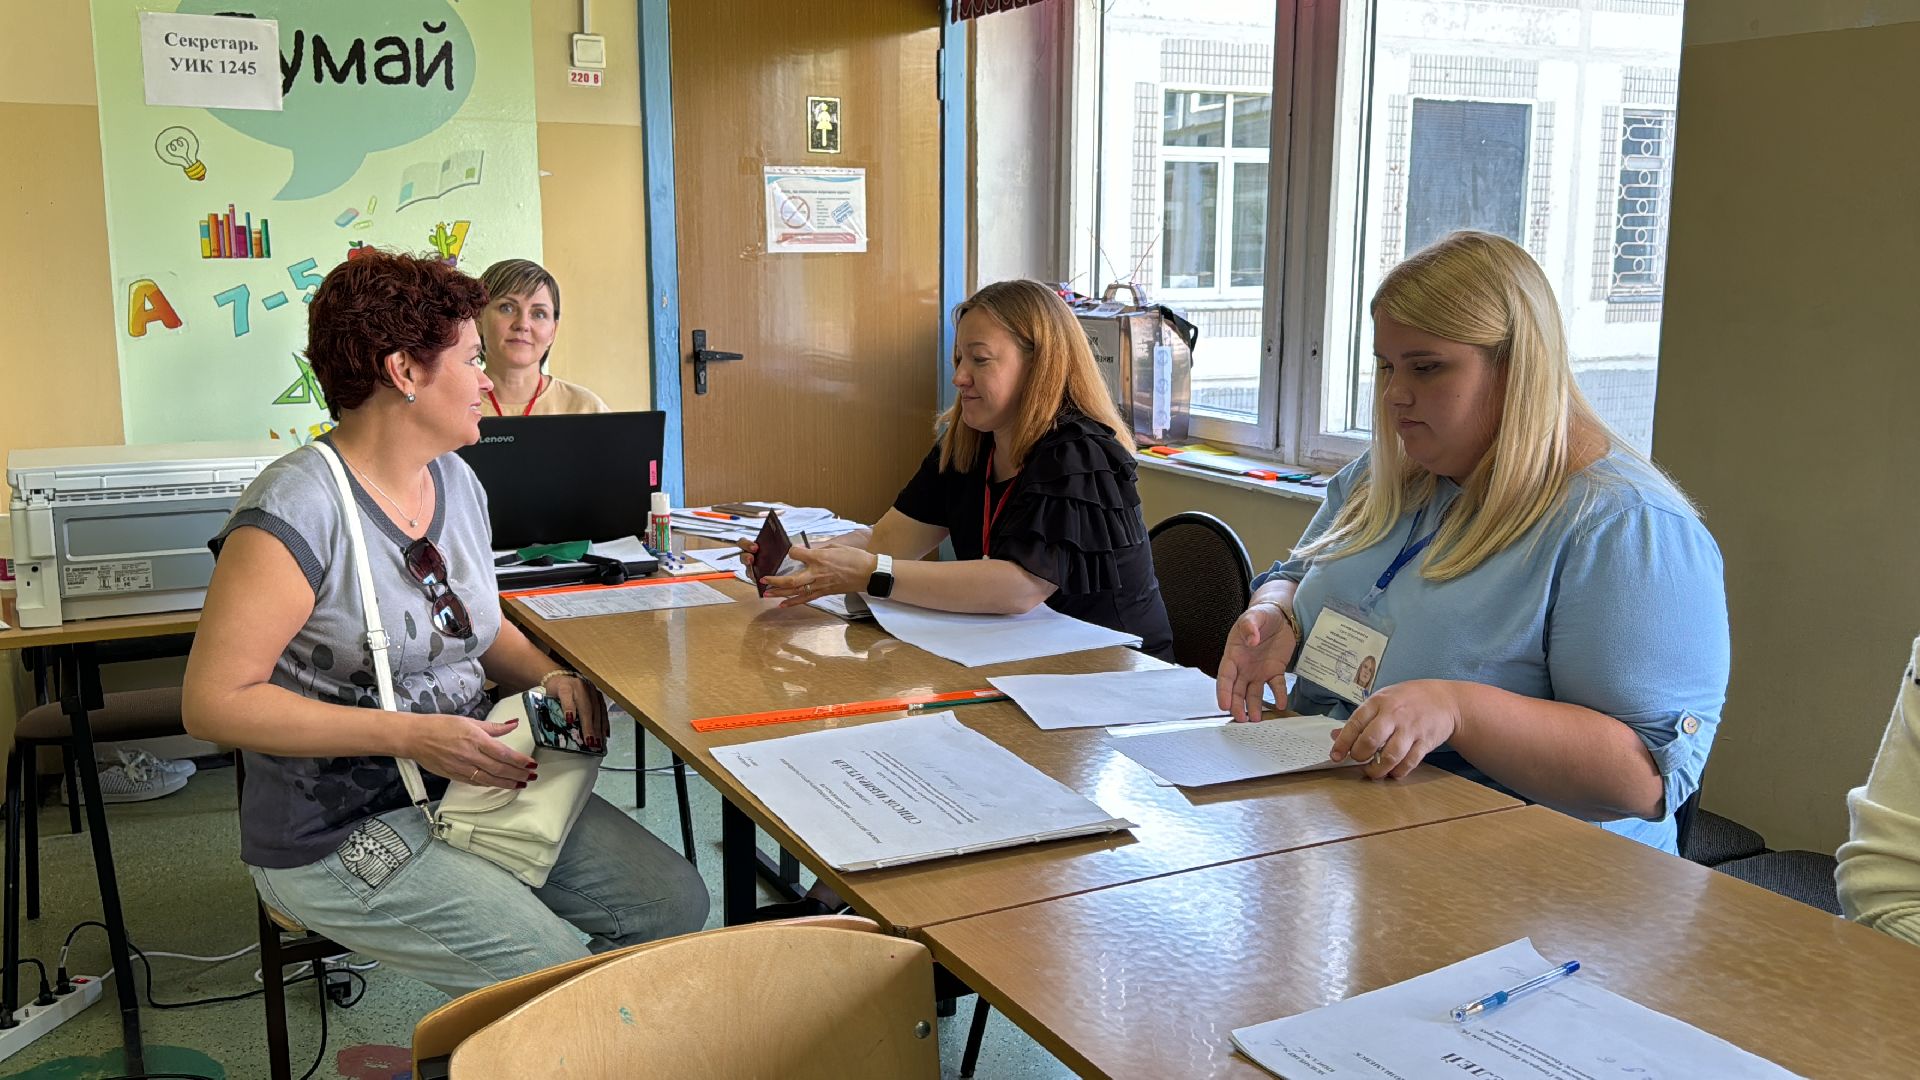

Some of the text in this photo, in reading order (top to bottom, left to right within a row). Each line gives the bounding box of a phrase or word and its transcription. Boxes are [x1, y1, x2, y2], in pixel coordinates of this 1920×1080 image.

[164, 31, 259, 52] Секретарь
[214, 12, 455, 98] умай
[169, 57, 257, 76] УИК 1245
[571, 72, 590, 83] 220
[480, 435, 515, 444] Lenovo
